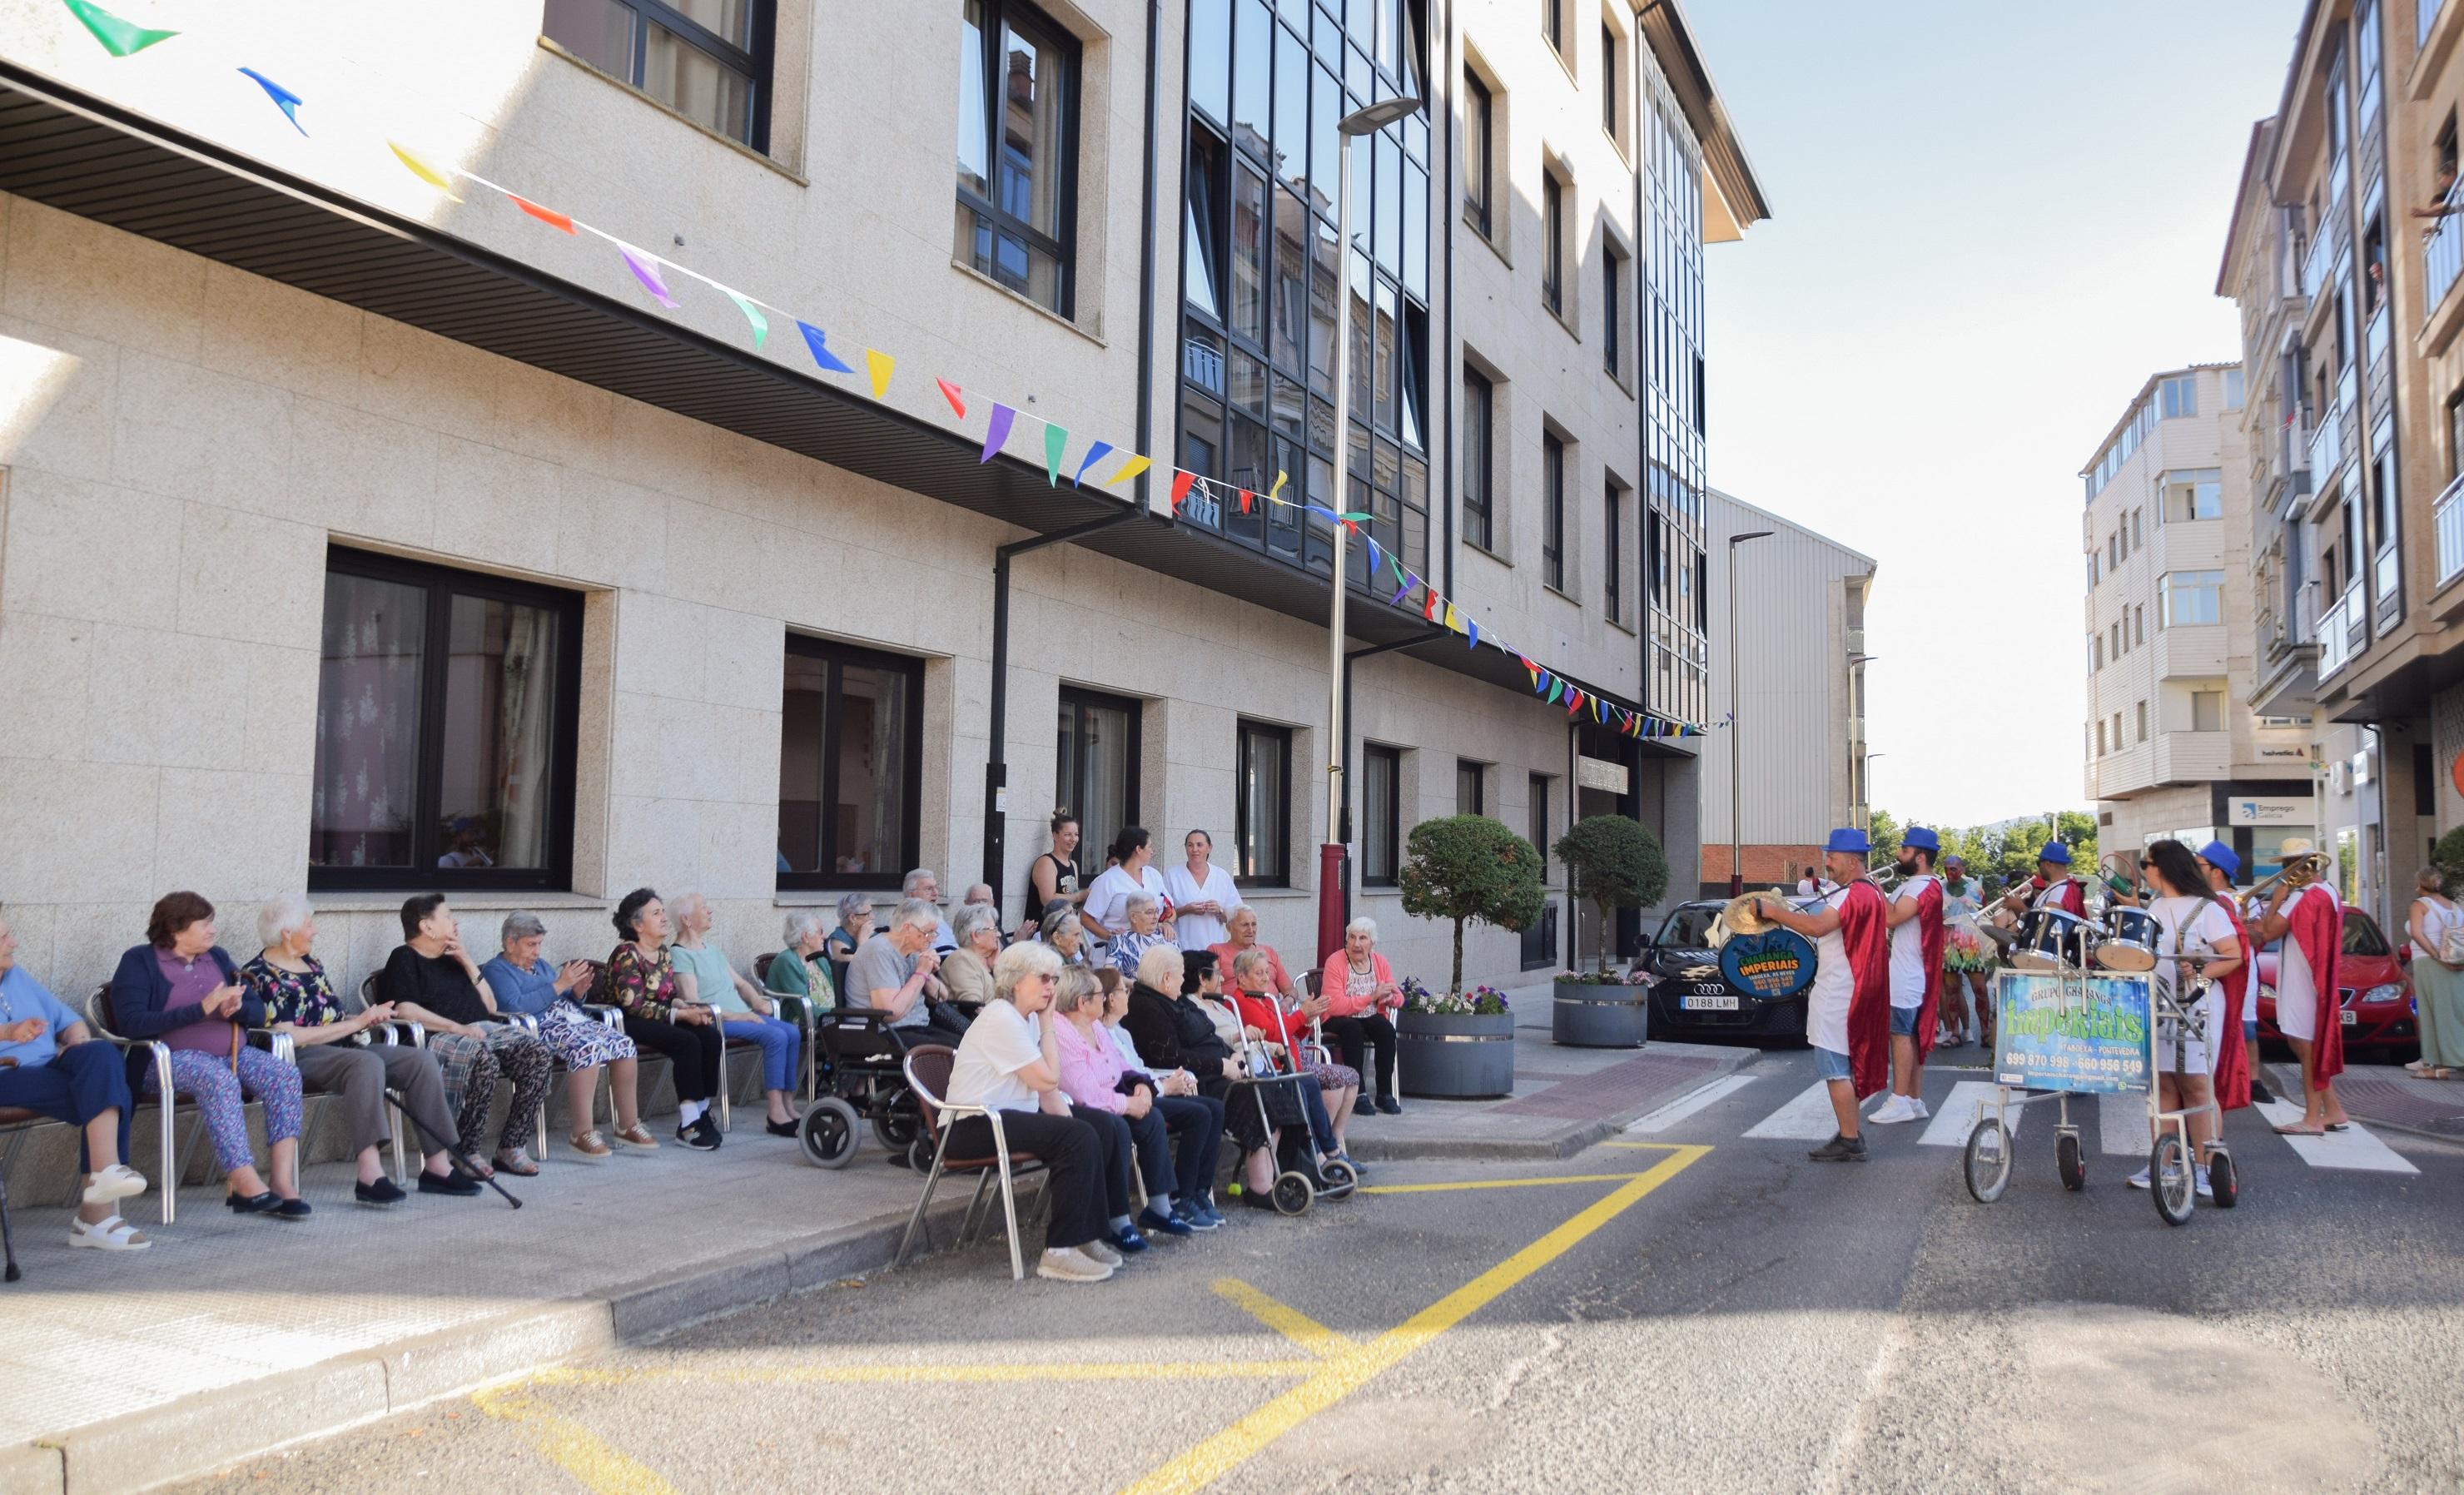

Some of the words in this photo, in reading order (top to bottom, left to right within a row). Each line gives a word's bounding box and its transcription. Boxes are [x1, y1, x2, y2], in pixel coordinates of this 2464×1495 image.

[2258, 804, 2295, 812] Emprego
[1740, 951, 1794, 966] CHARANGA
[1739, 959, 1799, 976] IMPERIAIS
[2031, 986, 2060, 1002] GRUPO
[1687, 998, 1713, 1008] 0188
[1716, 998, 1736, 1008] LMH
[2098, 1046, 2140, 1056] PONTEVEDRA
[2006, 1051, 2025, 1065] 699
[2027, 1053, 2047, 1067] 870
[2049, 1055, 2069, 1069] 998
[2078, 1056, 2098, 1070] 660
[2099, 1057, 2120, 1072] 956
[2122, 1059, 2144, 1074] 549
